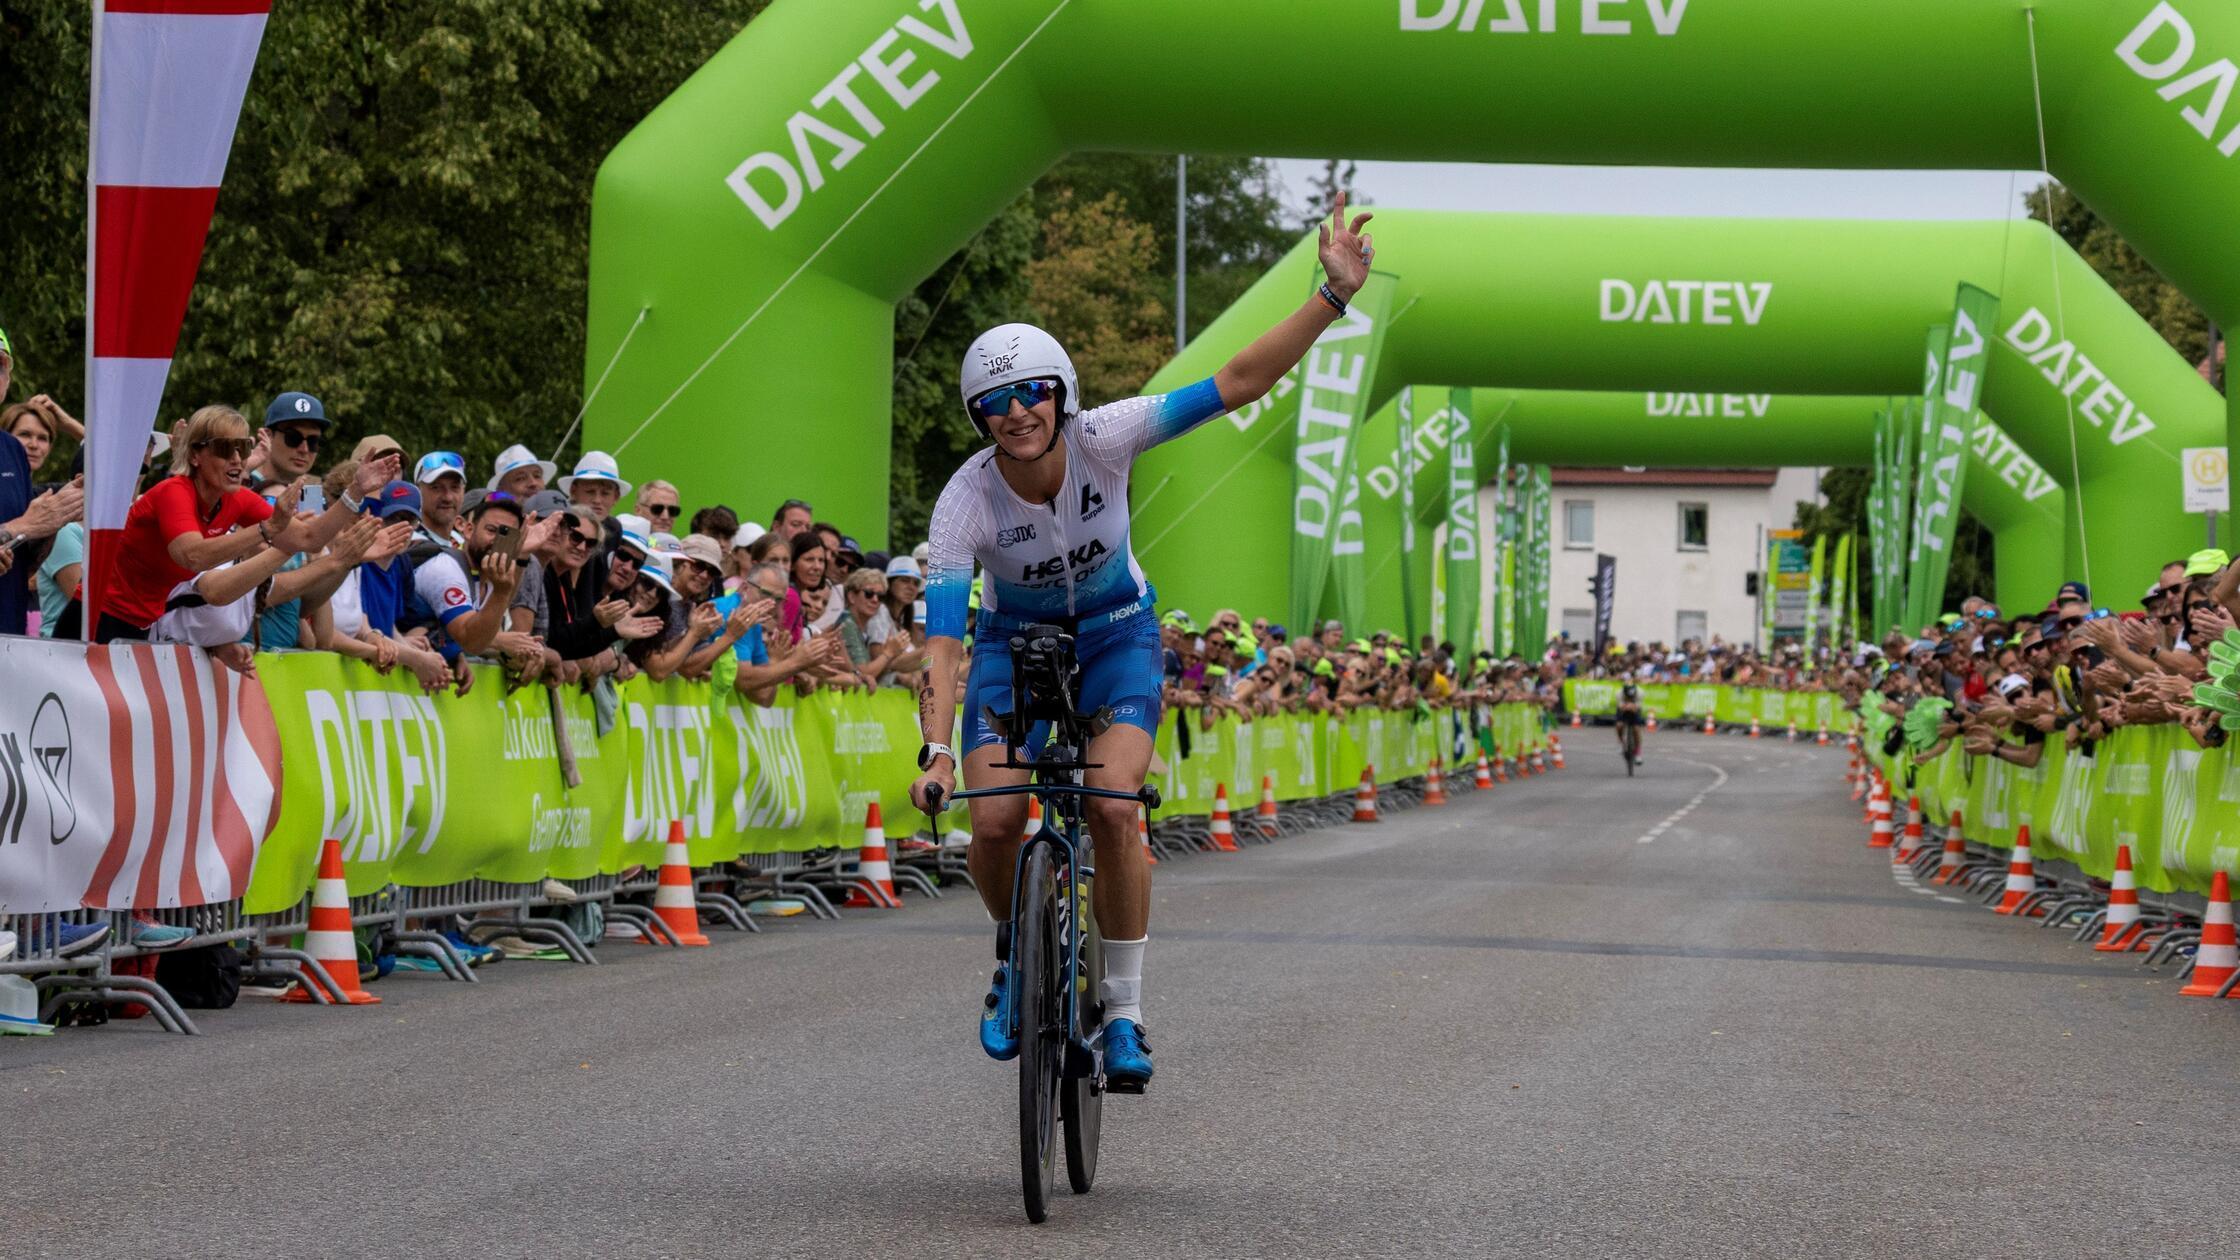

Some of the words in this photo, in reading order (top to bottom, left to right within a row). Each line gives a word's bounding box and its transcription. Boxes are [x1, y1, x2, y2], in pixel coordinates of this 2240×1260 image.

[725, 0, 974, 231] DATEV
[1600, 279, 1772, 325] DATEV
[988, 354, 1011, 368] 105
[2004, 307, 2156, 446] DATEV
[1295, 302, 1373, 539] DATEV
[1645, 391, 1771, 417] DATEV
[1451, 405, 1475, 560] DATEV
[1973, 420, 2059, 502] ATEV
[1014, 523, 1036, 543] JDC
[1022, 538, 1108, 581] HOKA
[1109, 601, 1142, 623] HOKA
[305, 689, 446, 866] DATEV
[622, 702, 714, 843] DATEV
